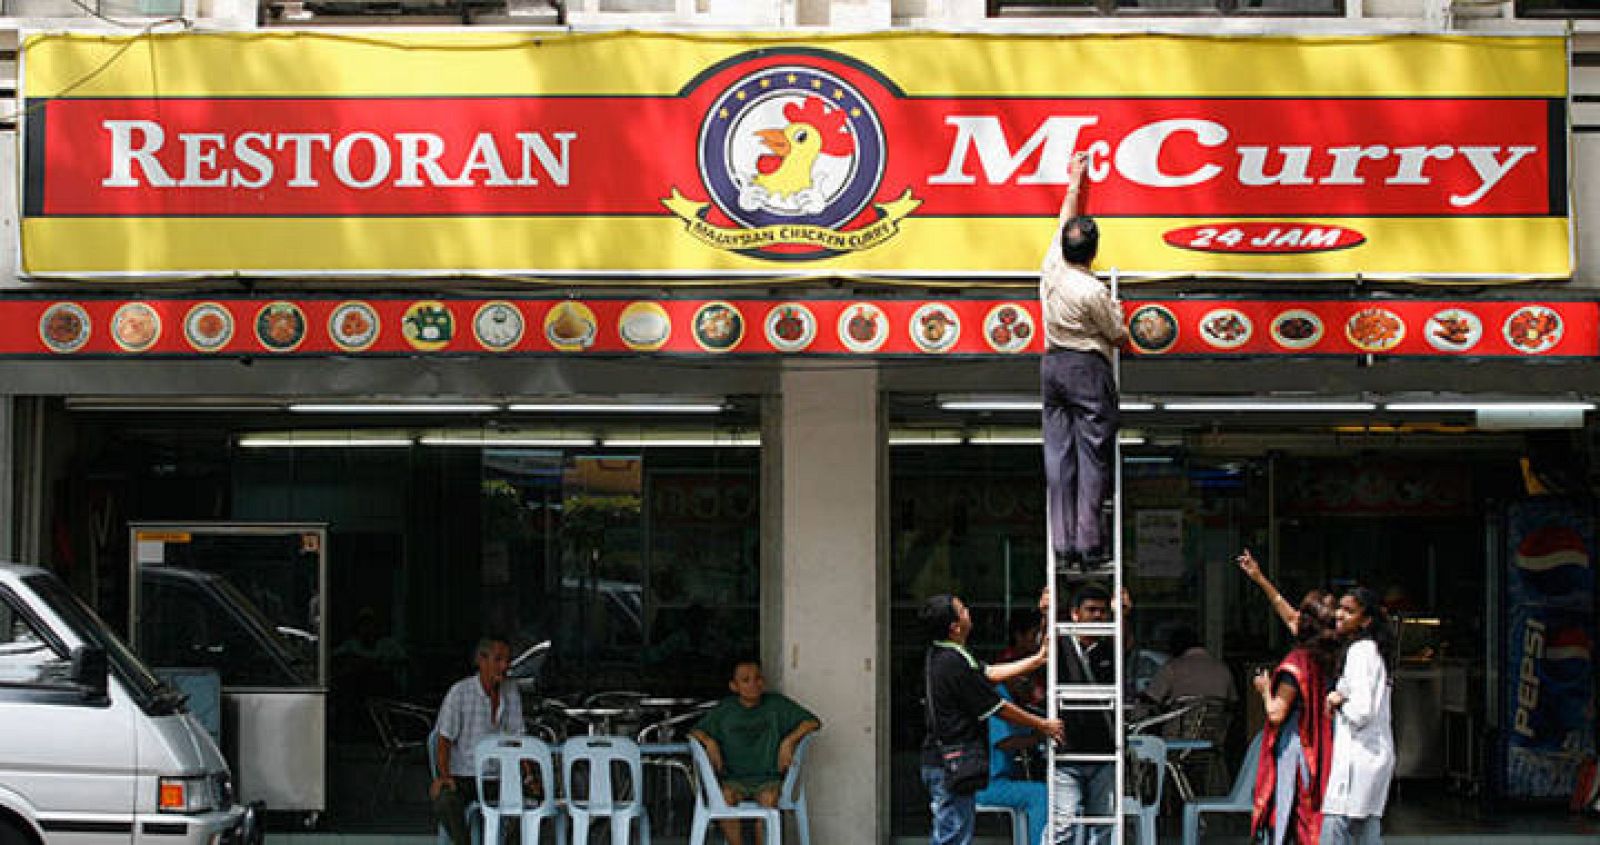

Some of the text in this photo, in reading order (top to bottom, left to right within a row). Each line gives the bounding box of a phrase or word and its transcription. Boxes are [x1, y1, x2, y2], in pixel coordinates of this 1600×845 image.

[101, 119, 577, 189] RESTORAN
[928, 115, 1537, 207] McCurry
[694, 221, 889, 247] MALAYSIAN CHICKEN CURRY
[1190, 228, 1341, 247] 24 JAM
[1513, 618, 1546, 738] PEPSI
